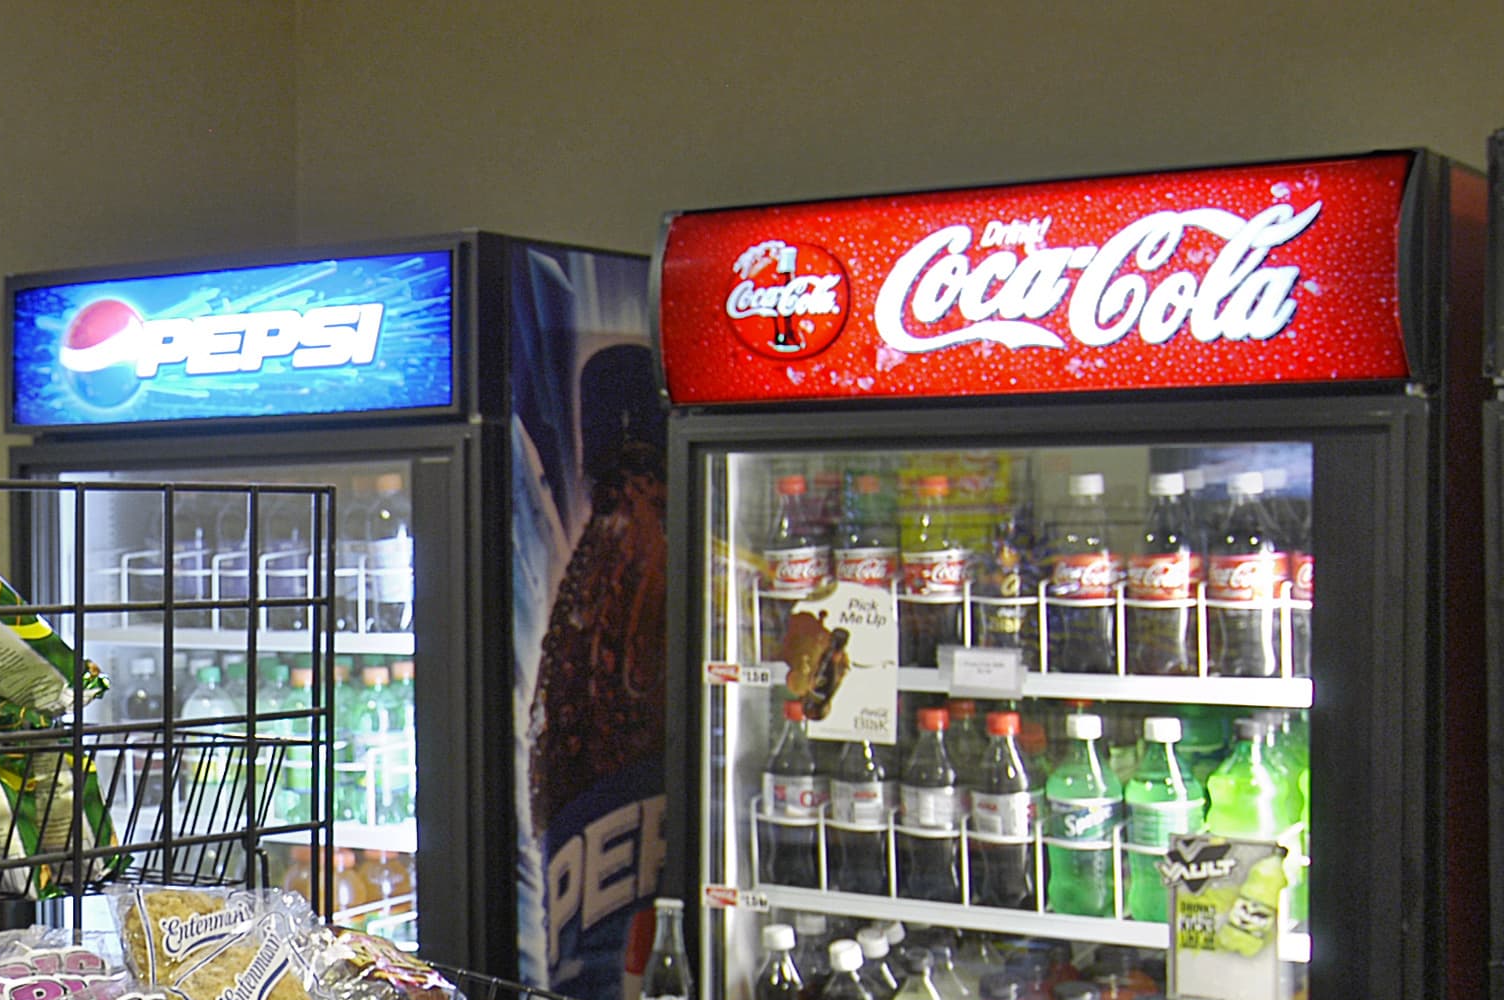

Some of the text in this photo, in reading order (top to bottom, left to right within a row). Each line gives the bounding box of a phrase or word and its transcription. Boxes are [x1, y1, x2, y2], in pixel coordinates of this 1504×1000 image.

[136, 302, 384, 379] PEPSI
[866, 614, 887, 628] Up
[1154, 858, 1236, 883] VAULT
